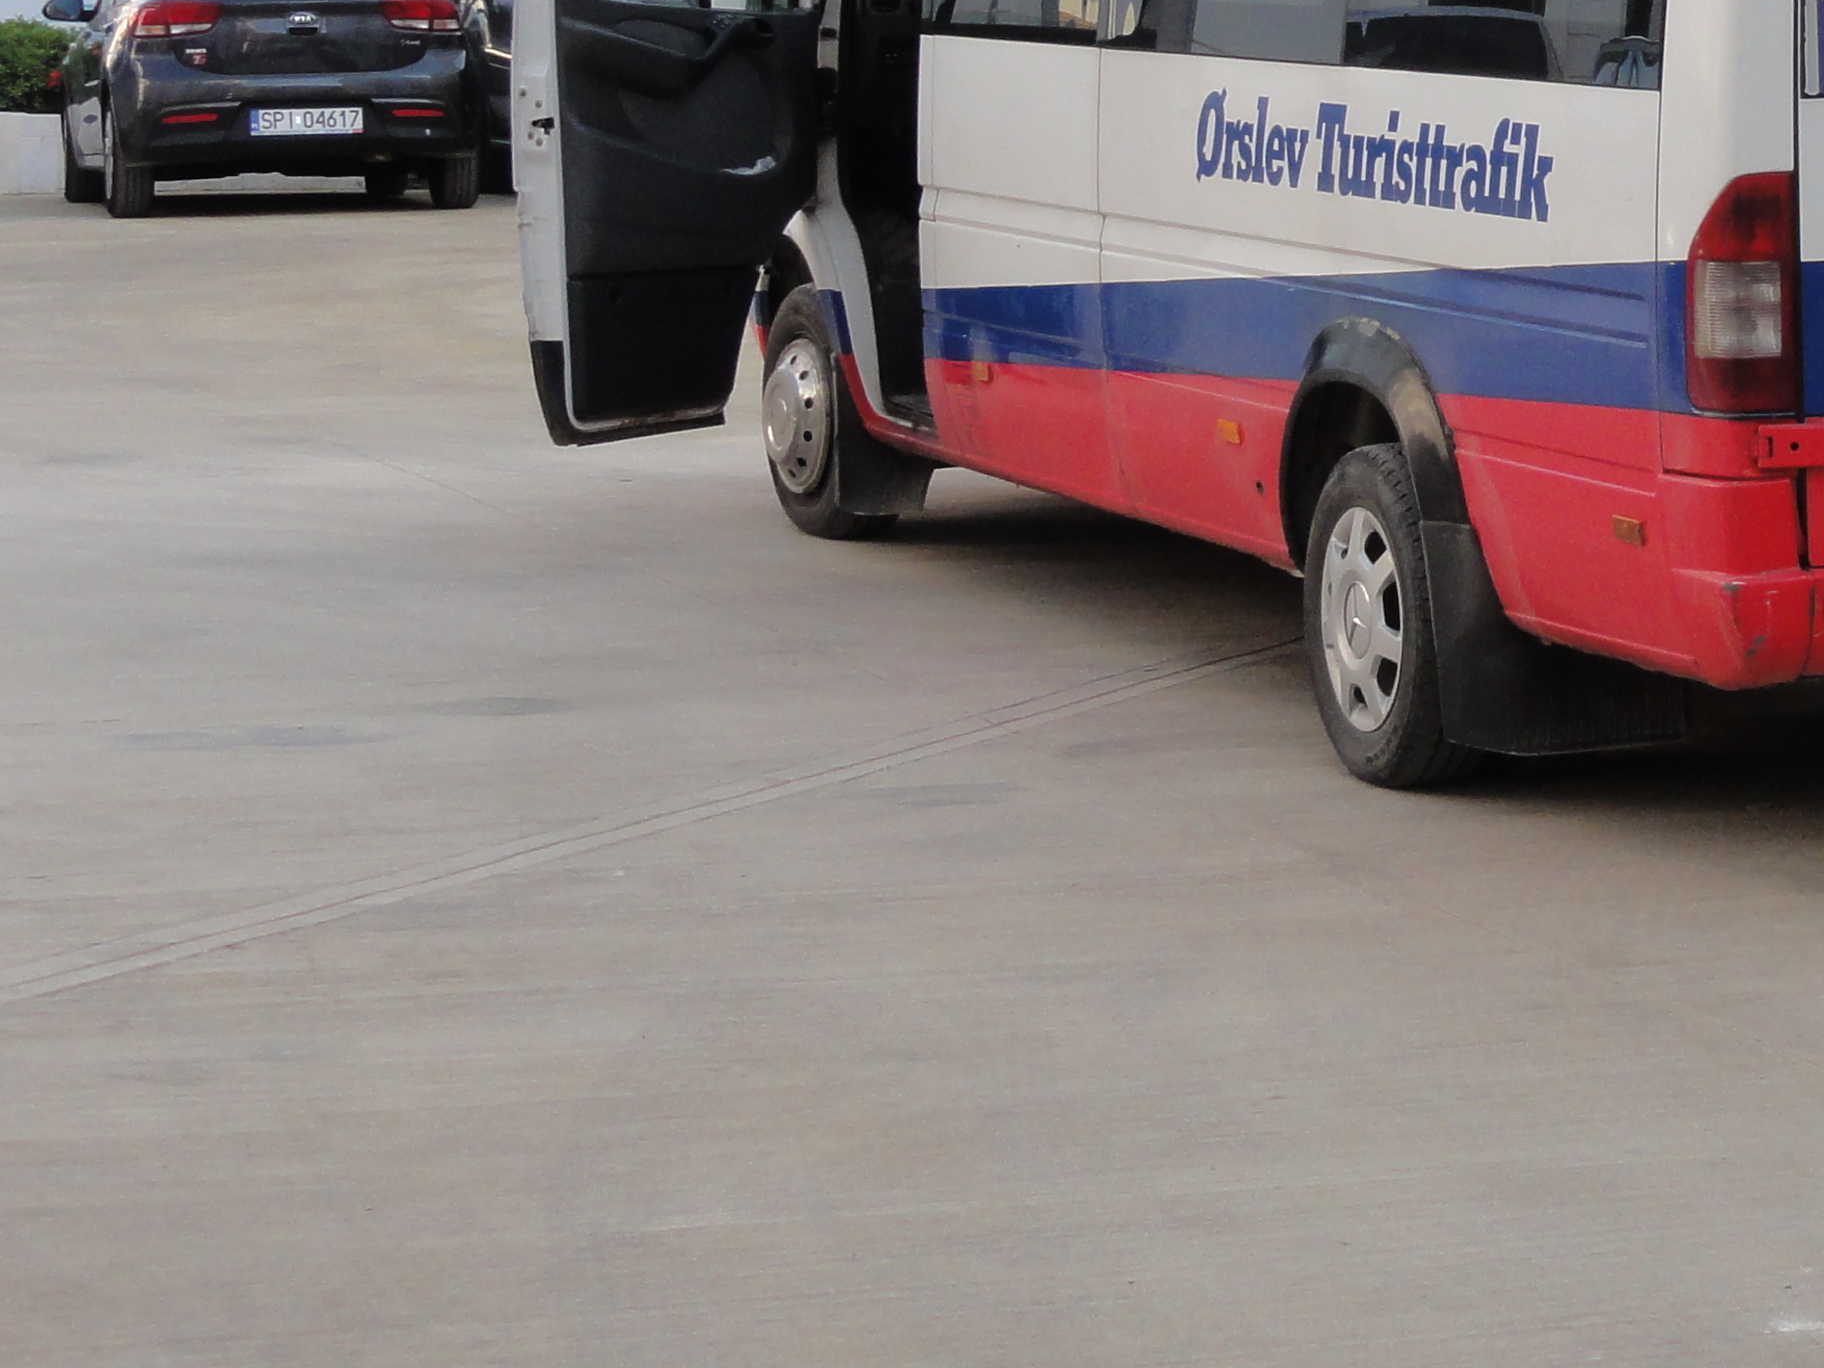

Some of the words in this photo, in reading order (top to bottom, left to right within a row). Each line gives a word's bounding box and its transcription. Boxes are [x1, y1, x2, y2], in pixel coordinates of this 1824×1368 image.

[261, 111, 294, 129] SPI
[303, 110, 360, 128] 04617
[1195, 87, 1309, 189] Ørslev
[1315, 101, 1554, 223] Turisttrafik
